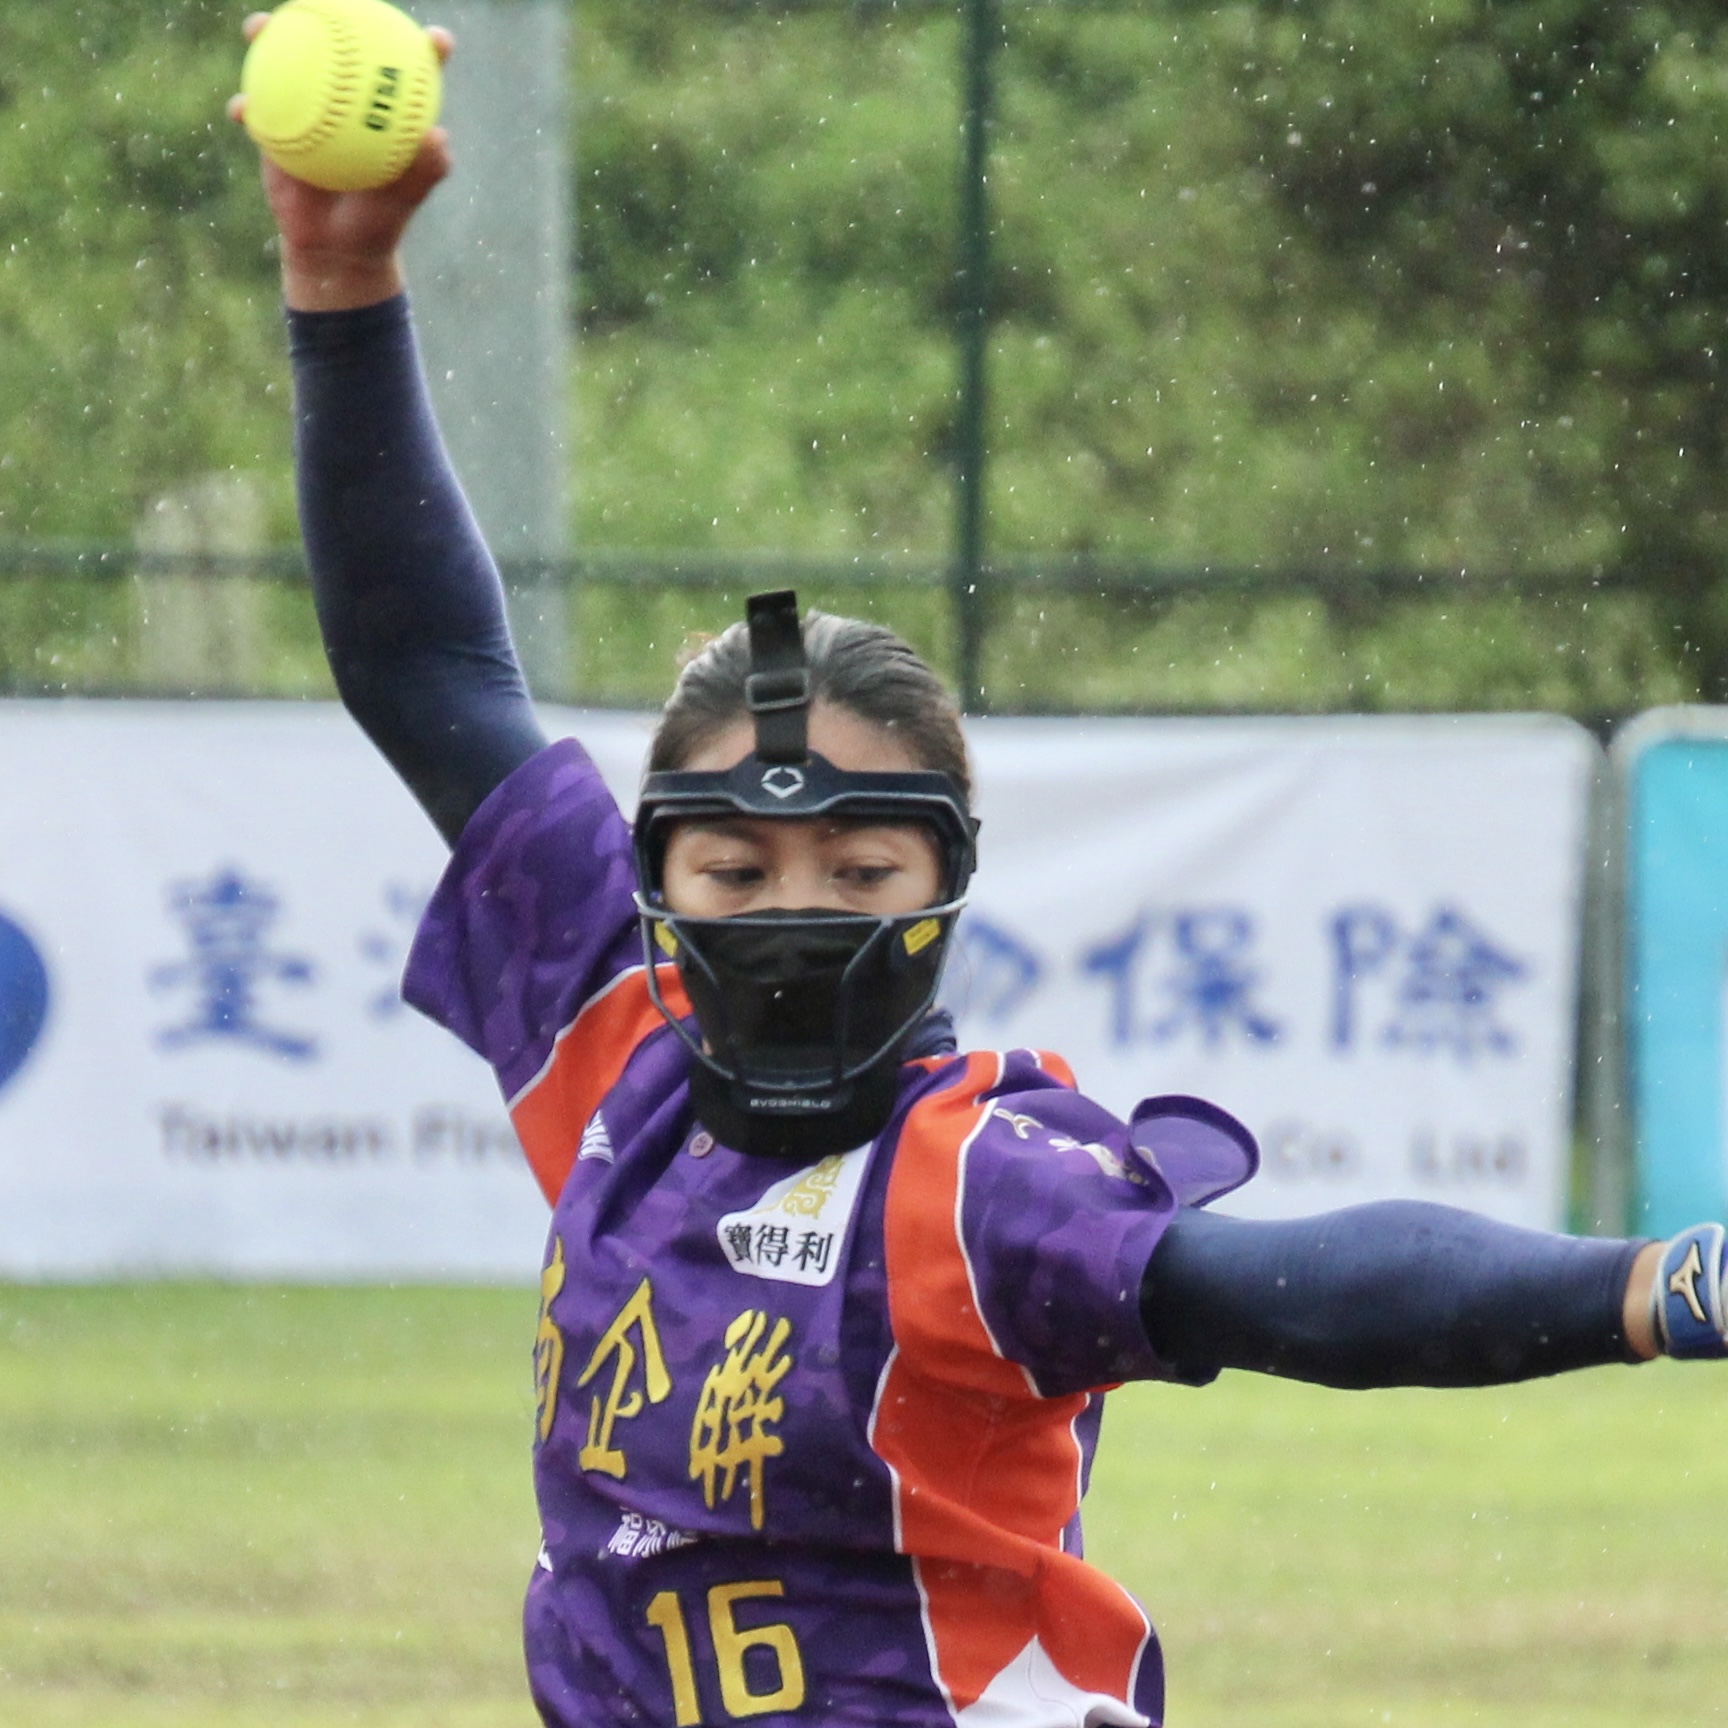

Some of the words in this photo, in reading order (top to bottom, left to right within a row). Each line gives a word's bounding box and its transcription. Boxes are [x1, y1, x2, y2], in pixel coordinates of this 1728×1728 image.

[157, 1104, 396, 1164] Taiwan
[724, 1221, 834, 1274] 寶得利
[646, 1579, 805, 1727] 16
